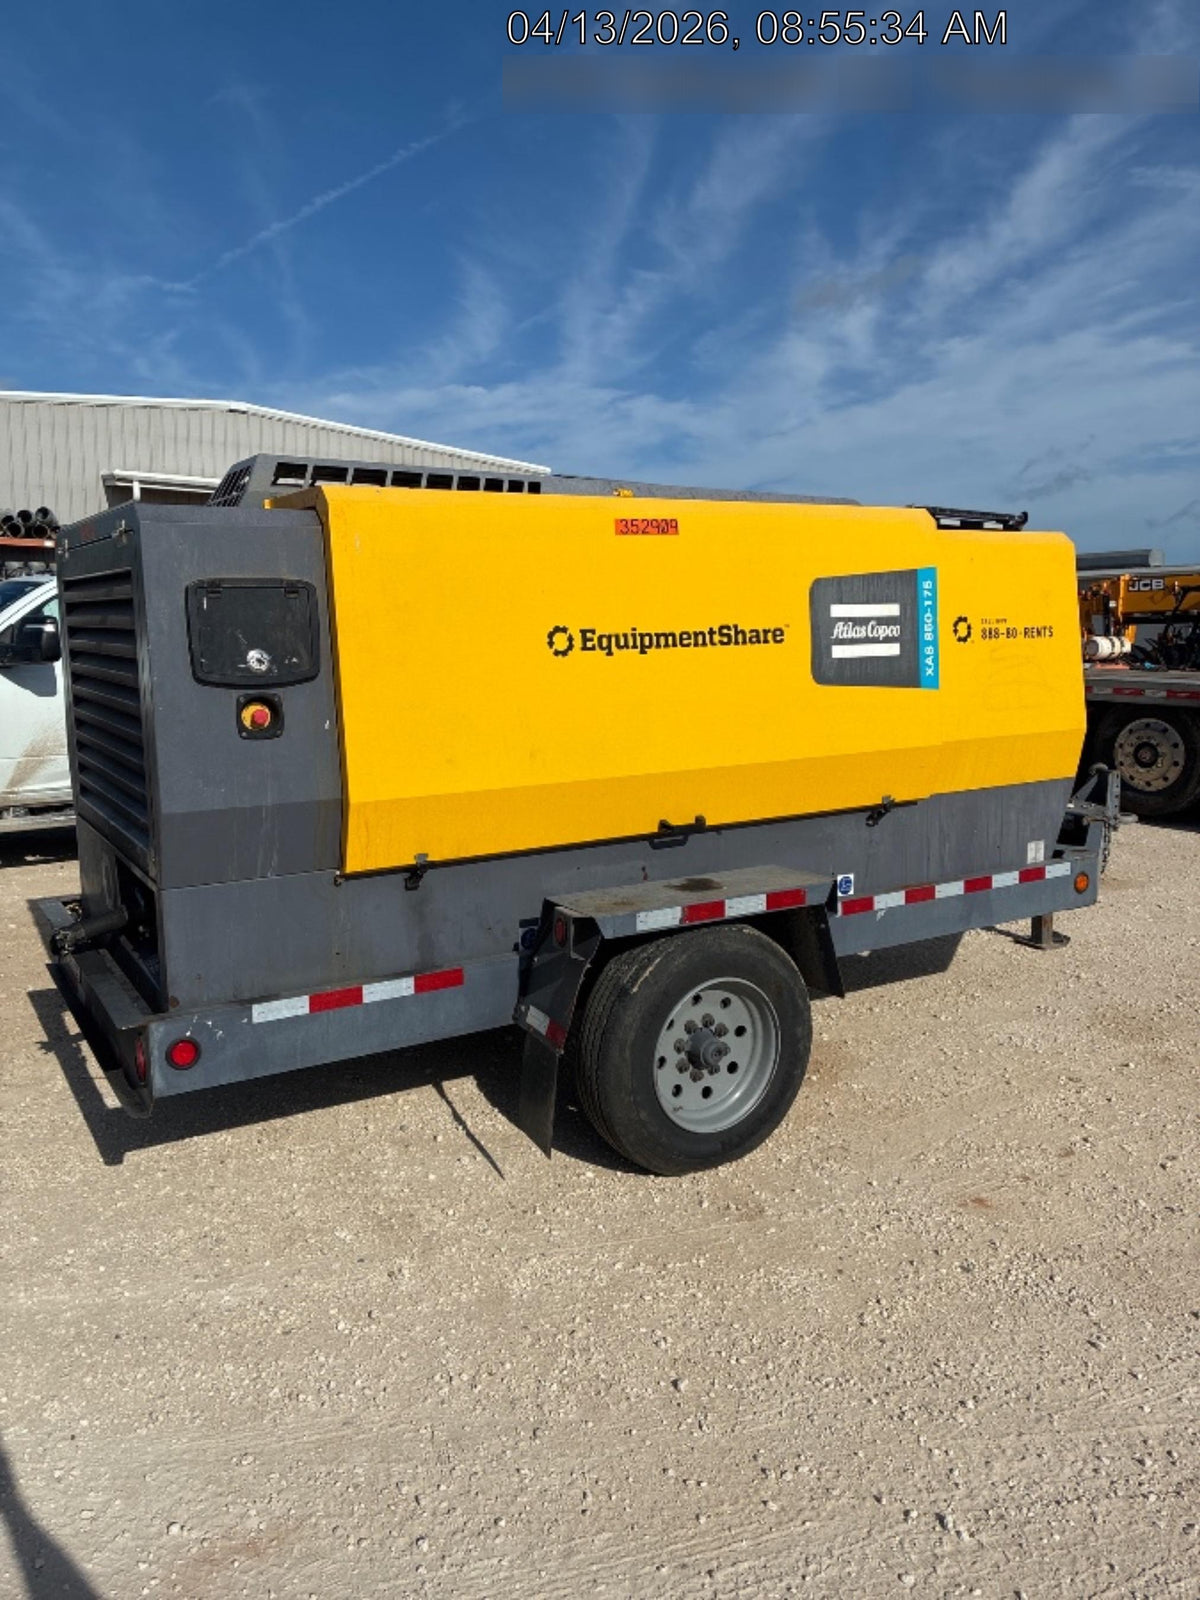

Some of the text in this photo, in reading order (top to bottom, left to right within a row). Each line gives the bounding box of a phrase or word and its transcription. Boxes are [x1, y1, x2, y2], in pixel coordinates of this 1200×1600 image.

[1128, 579, 1164, 591] JCB
[579, 623, 786, 656] EquipmentShare
[830, 619, 901, 641] Atlas Copco
